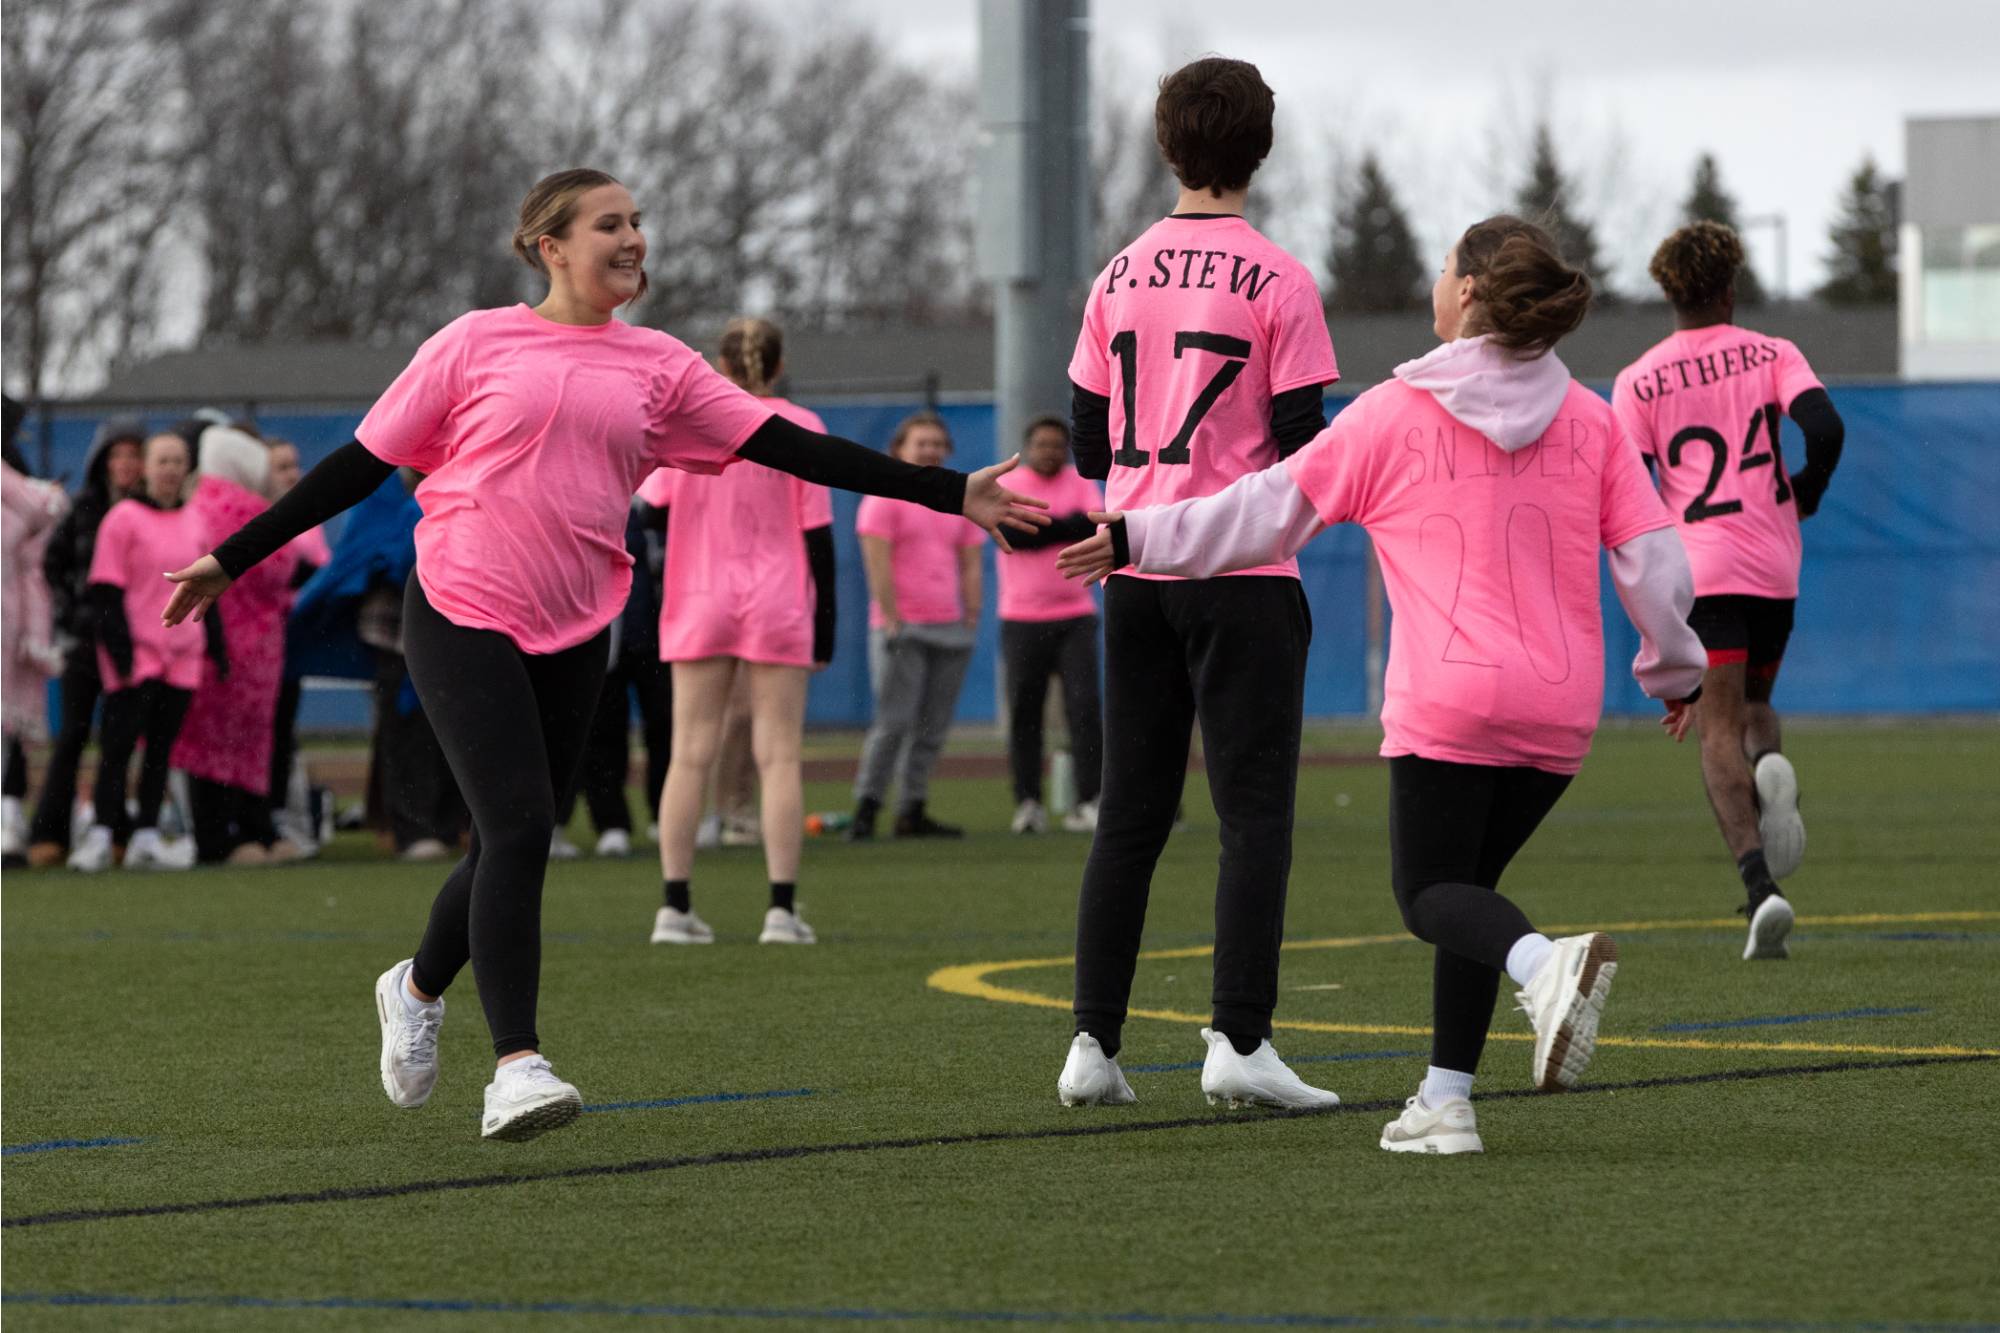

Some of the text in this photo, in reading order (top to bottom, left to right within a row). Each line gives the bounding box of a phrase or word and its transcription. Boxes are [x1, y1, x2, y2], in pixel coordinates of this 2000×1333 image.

[1106, 249, 1279, 302] P. STEW
[1110, 330, 1252, 468] 17
[1633, 342, 1779, 402] GETHERS
[1668, 402, 1791, 524] 24
[1419, 502, 1571, 685] 20
